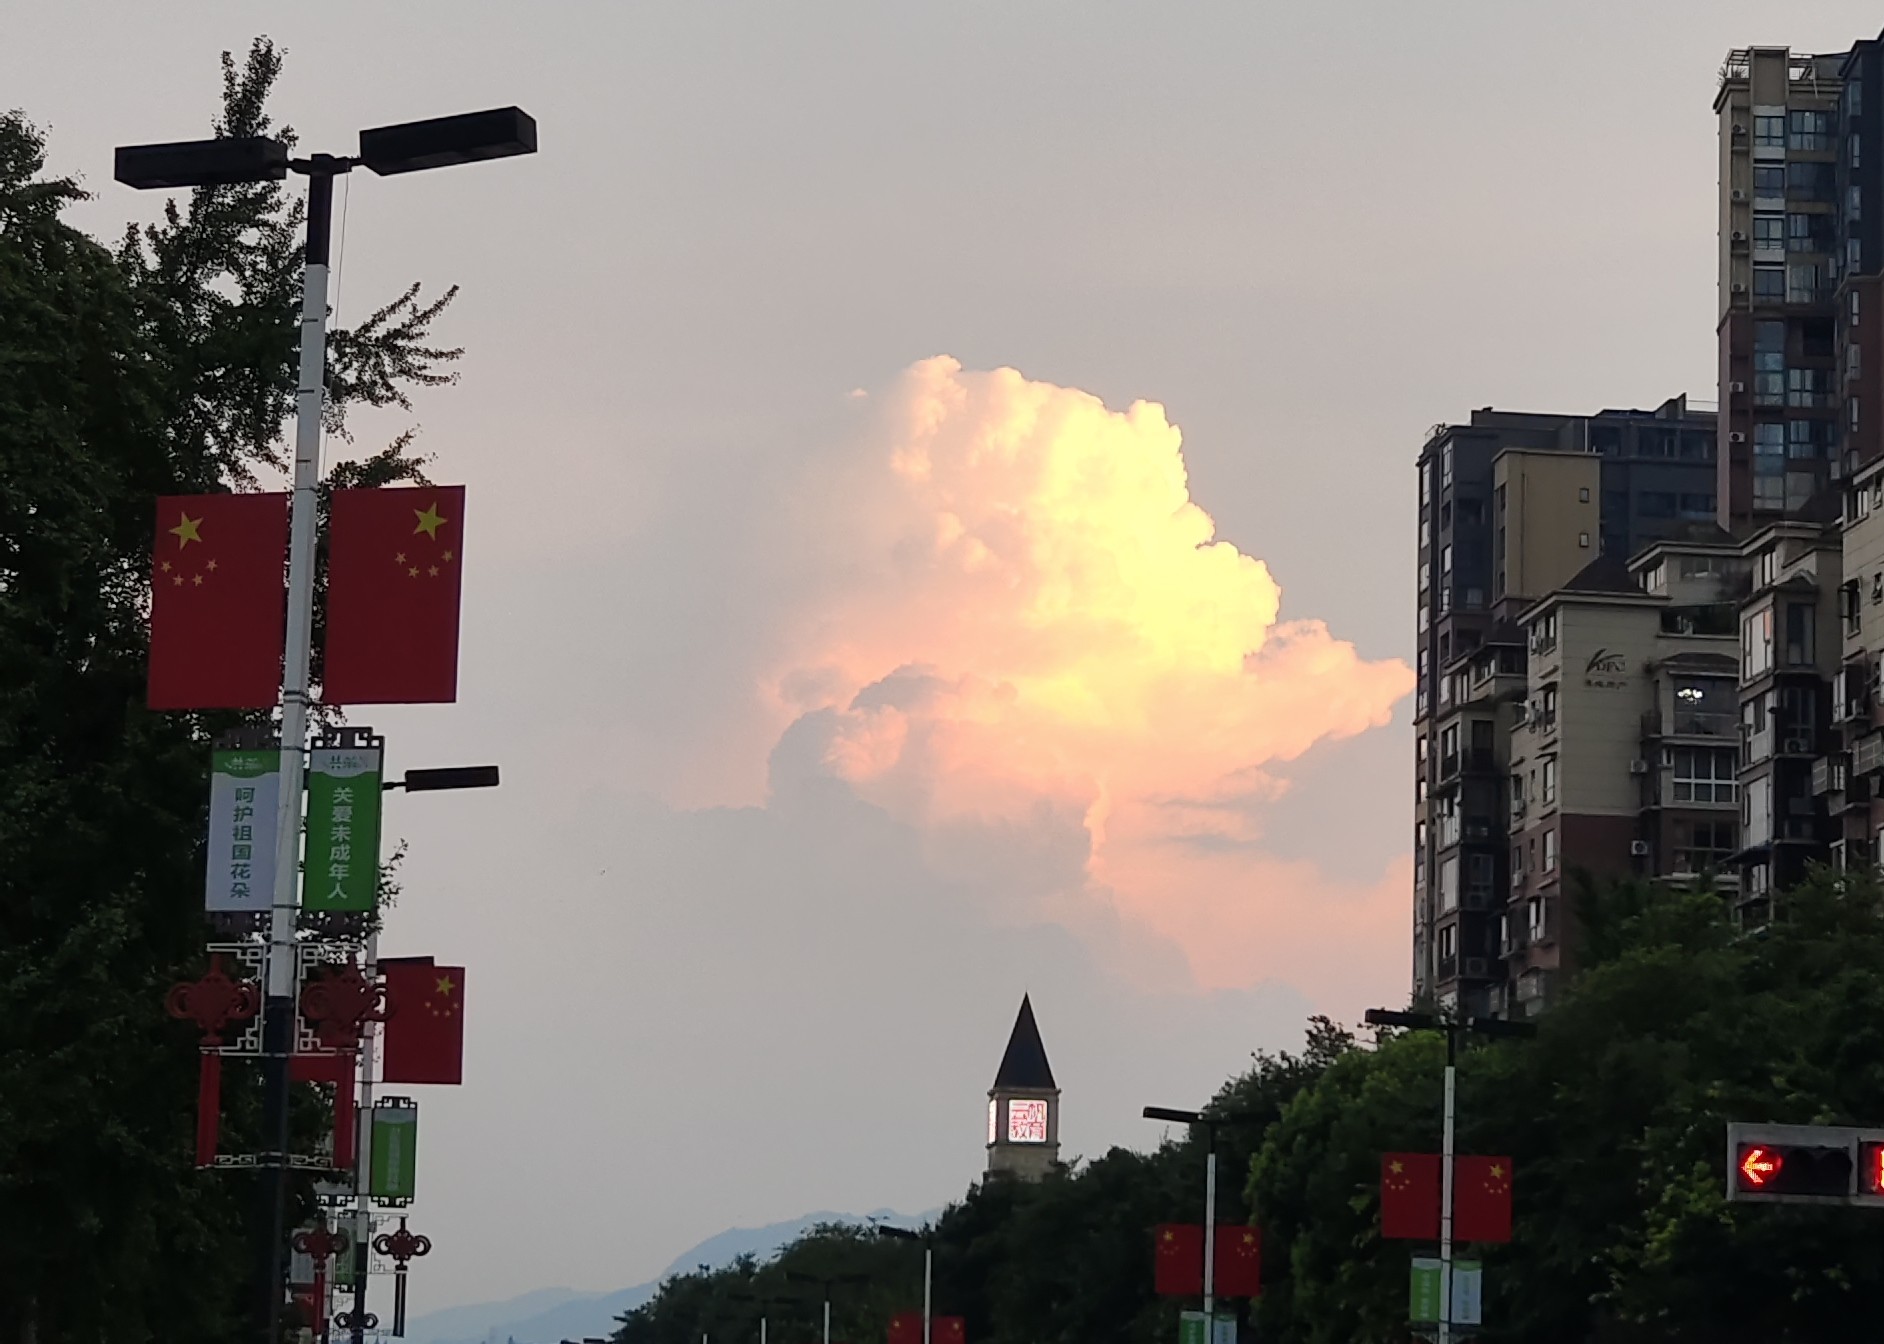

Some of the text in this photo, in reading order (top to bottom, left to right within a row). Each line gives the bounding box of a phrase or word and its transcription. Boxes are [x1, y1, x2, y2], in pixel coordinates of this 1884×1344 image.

[230, 787, 256, 899] 呵护祖国花朵
[327, 787, 355, 900] 关爱未成年人
[1010, 1120, 1044, 1140] 教育
